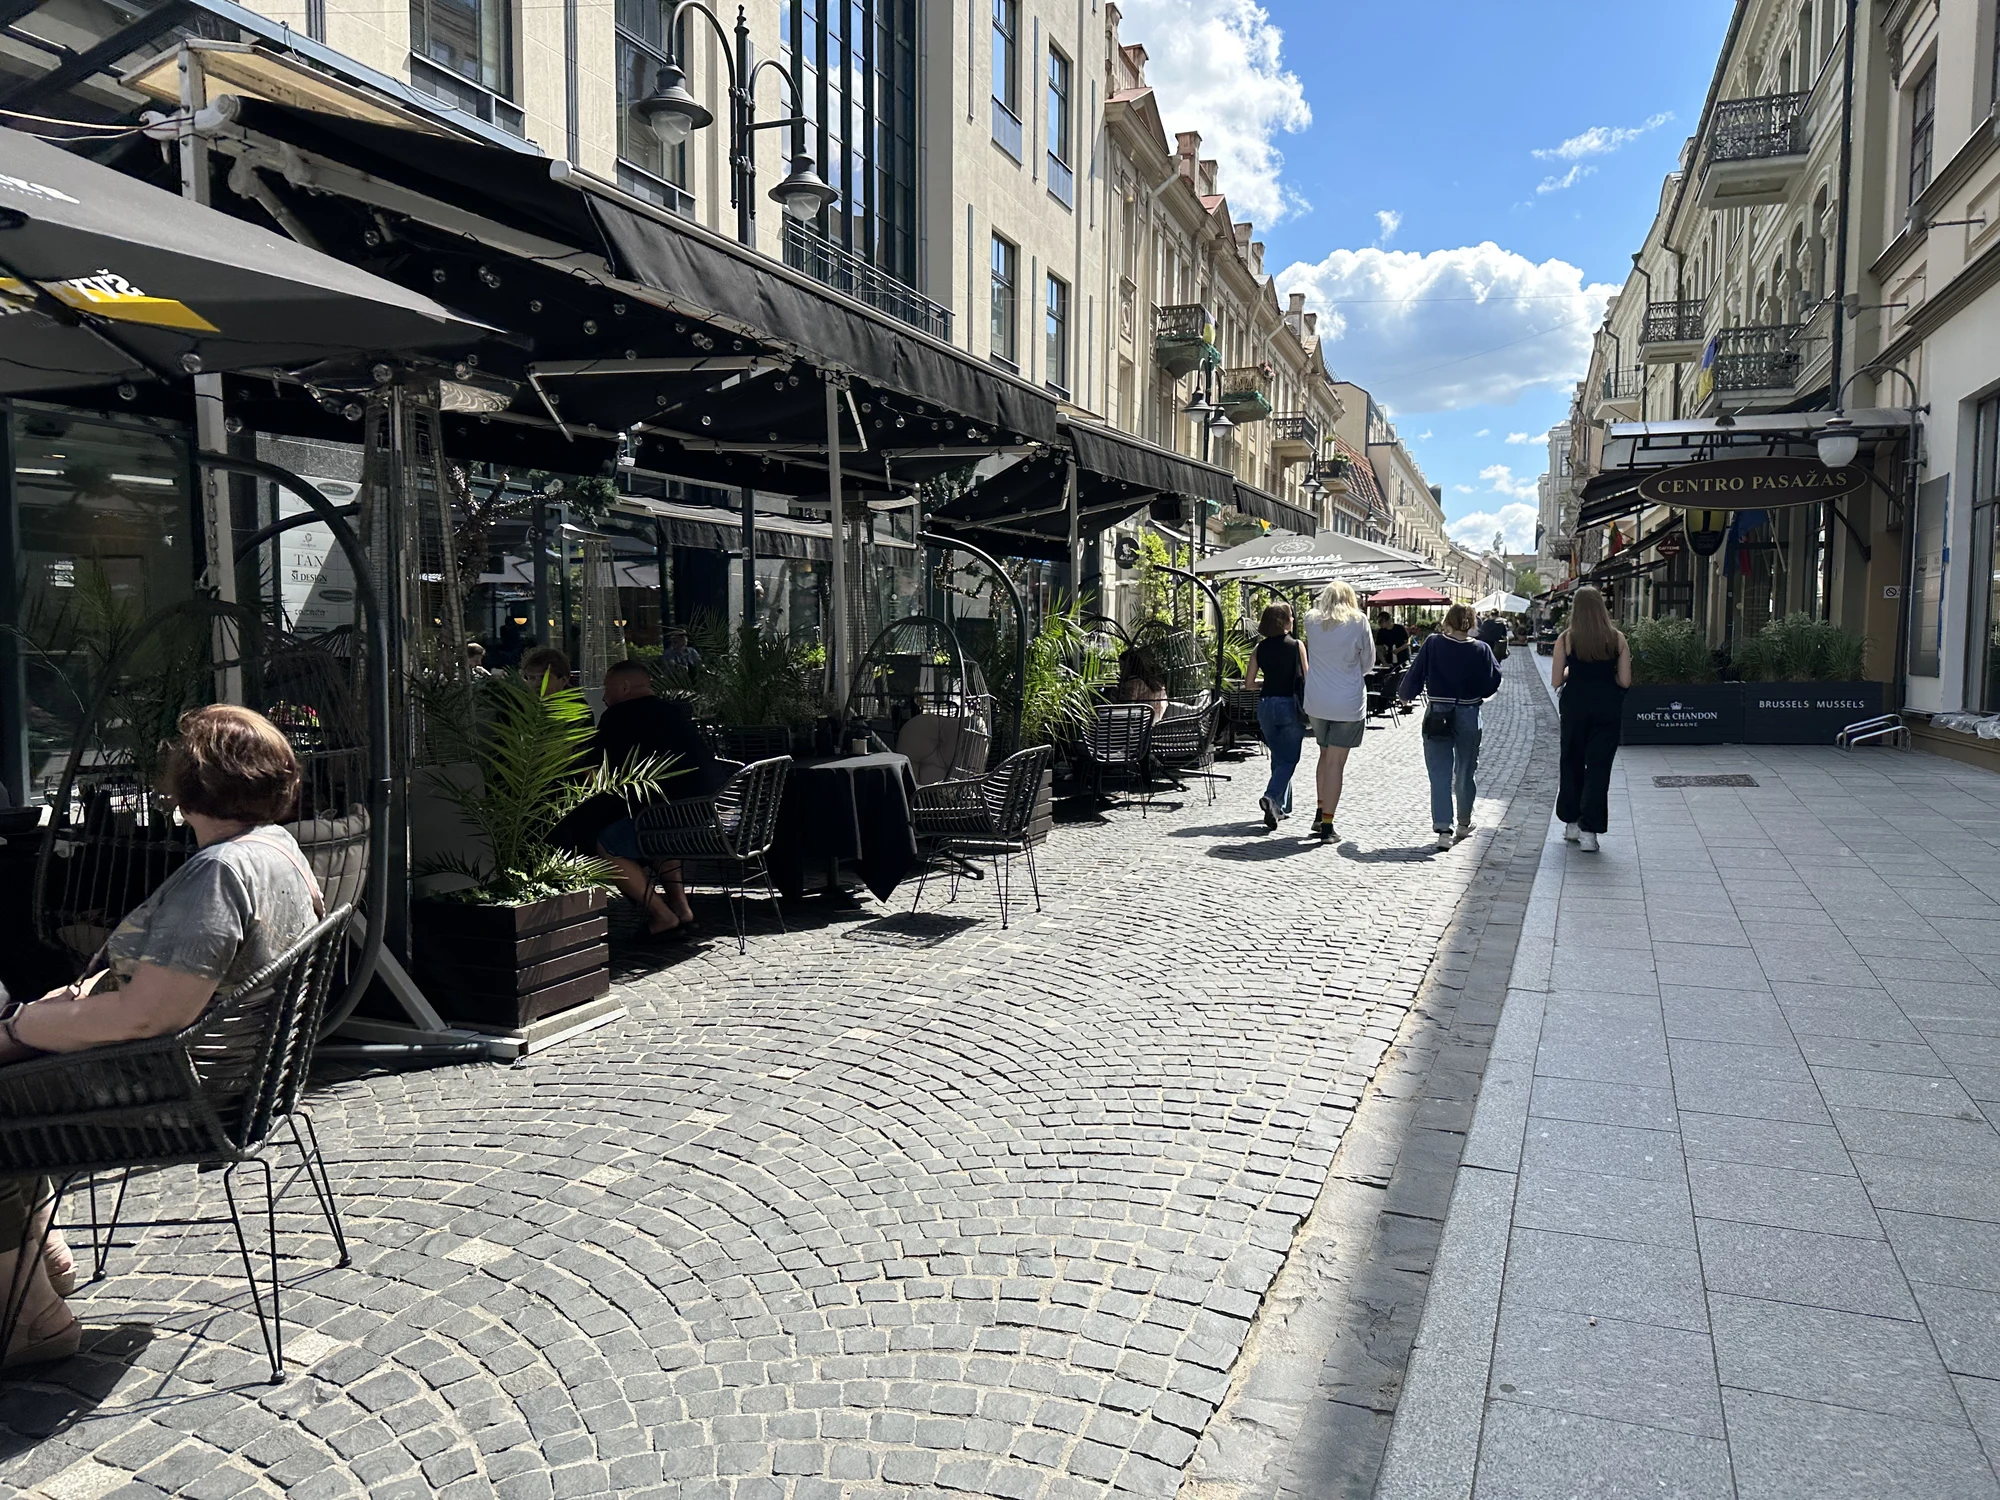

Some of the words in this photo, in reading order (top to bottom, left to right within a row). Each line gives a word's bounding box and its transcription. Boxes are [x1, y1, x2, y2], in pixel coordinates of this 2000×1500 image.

[1657, 477, 1744, 494] CENTRO
[1752, 469, 1848, 490] PASAŽAS
[294, 554, 324, 567] TAN
[300, 573, 328, 582] DESIGN
[1759, 700, 1810, 708] BRUSSELS
[1816, 700, 1865, 708] MUSSELS
[1636, 712, 1662, 721] MOËT
[1672, 712, 1718, 720] CHANDON
